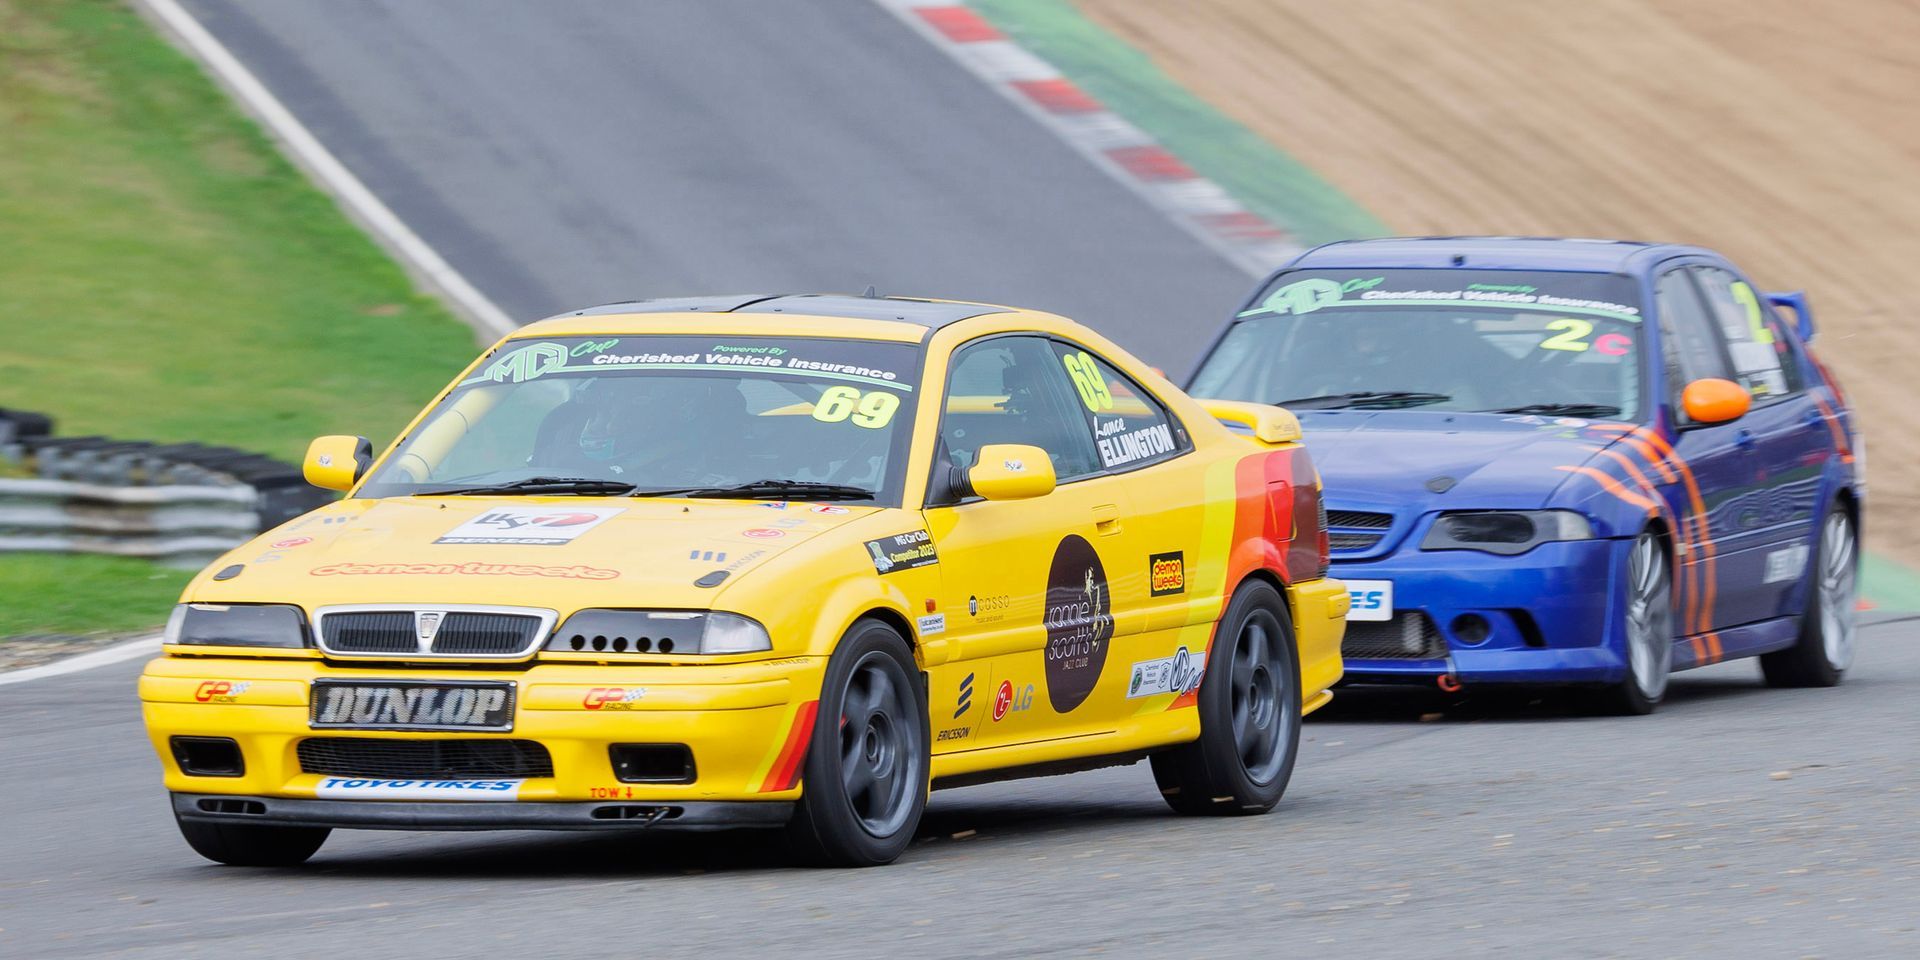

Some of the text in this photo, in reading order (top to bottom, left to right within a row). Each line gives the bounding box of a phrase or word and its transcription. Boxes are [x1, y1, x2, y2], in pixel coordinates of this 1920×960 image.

[484, 339, 619, 383] MG Cup
[712, 345, 788, 356] Powered By
[592, 352, 897, 380] Cherished Vehicle Insurance
[1063, 351, 1113, 412] 69
[812, 385, 900, 429] 69
[1093, 415, 1127, 440] Lance
[1097, 423, 1175, 467] ELLINGTON
[894, 530, 929, 546] MG Car Club
[890, 548, 920, 563] Competitor
[1153, 559, 1182, 576] demon
[1152, 574, 1184, 591] tweeks
[1049, 595, 1090, 629] ronnie
[1349, 591, 1384, 609] ES
[1048, 626, 1093, 660] scott's
[1171, 649, 1189, 691] MG
[321, 686, 507, 725] DUNLOP
[1012, 683, 1034, 712] LG
[937, 726, 971, 742] ERICSSON
[591, 788, 620, 798] TOW
